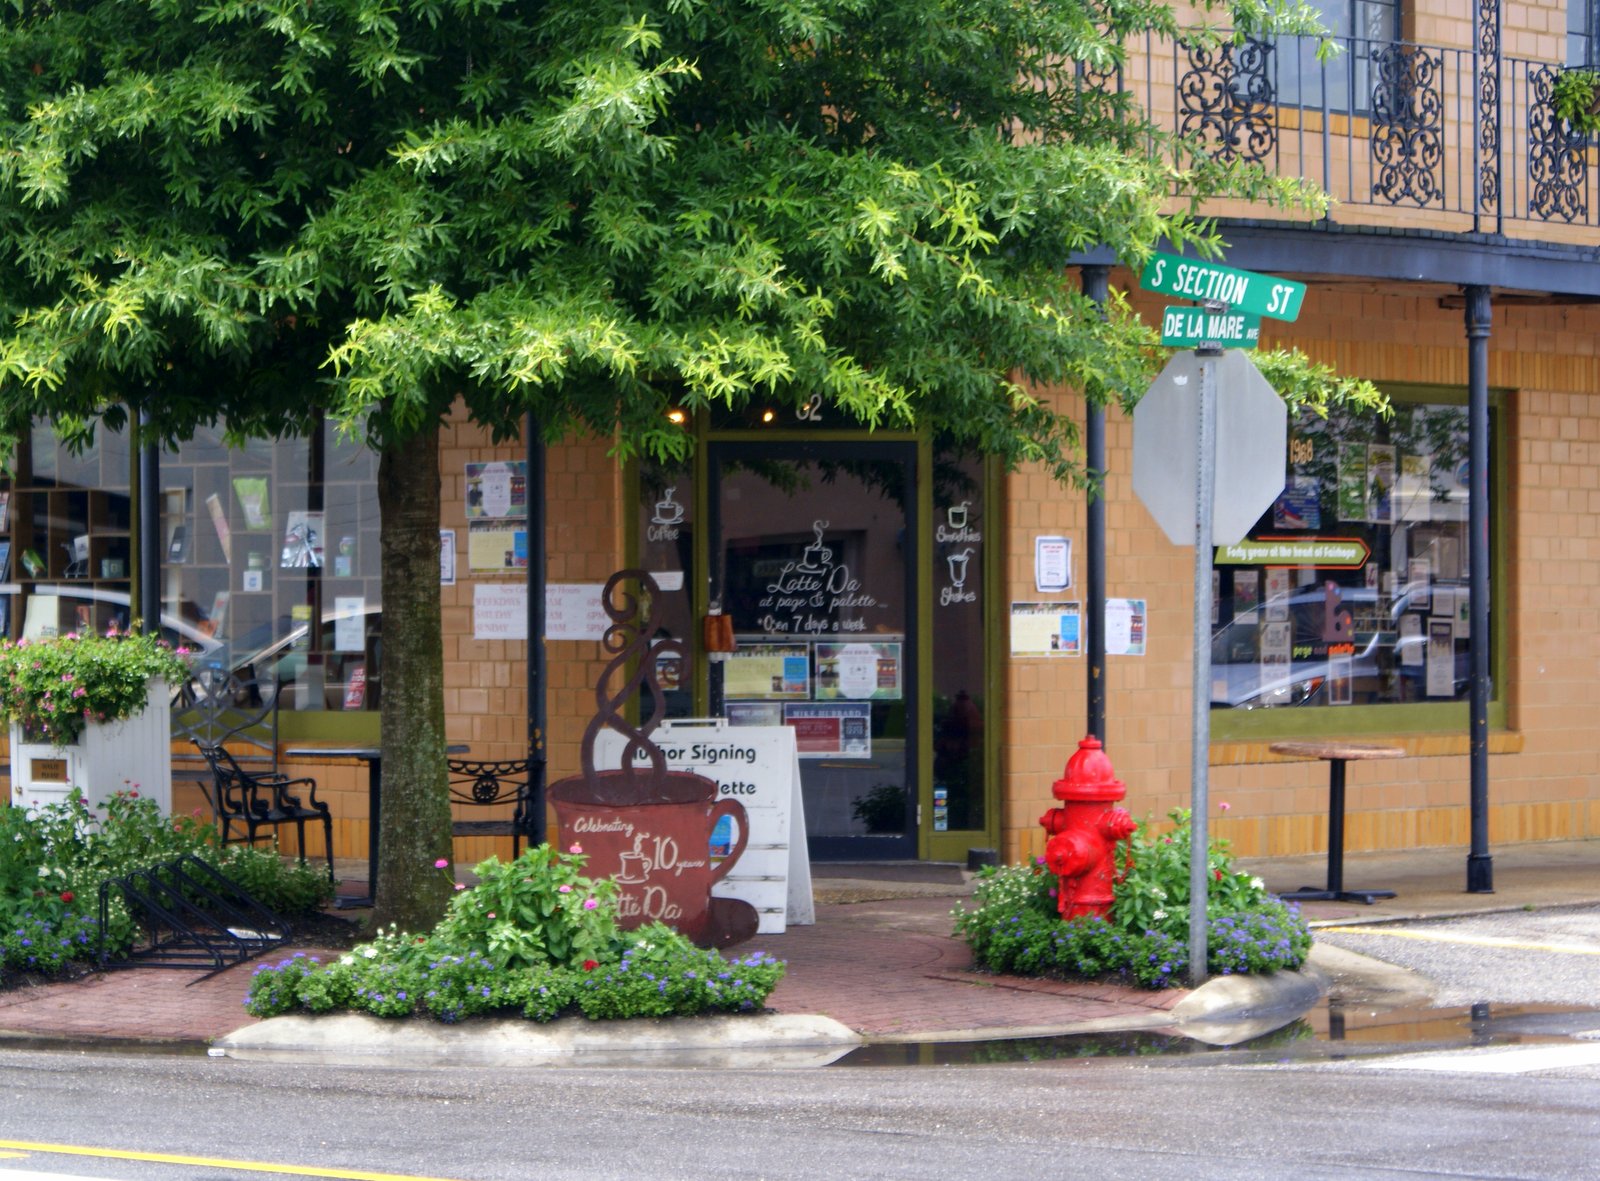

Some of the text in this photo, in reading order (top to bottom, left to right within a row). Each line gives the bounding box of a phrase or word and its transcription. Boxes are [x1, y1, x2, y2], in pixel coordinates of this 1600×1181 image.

[1151, 259, 1295, 314] S SECTION ST
[1164, 313, 1259, 340] DE LA MARE AVE
[647, 524, 680, 542] Coffee
[766, 561, 862, 594] Latte Da
[759, 596, 774, 607] at
[775, 597, 808, 613] page
[809, 590, 825, 608] &
[940, 586, 976, 606] Shakes
[792, 615, 803, 633] 7
[804, 613, 829, 636] days
[842, 616, 868, 632] week
[691, 744, 756, 764] Signing
[573, 817, 635, 838] Celebrating
[652, 837, 705, 877] 10 years
[642, 886, 682, 919] Da
